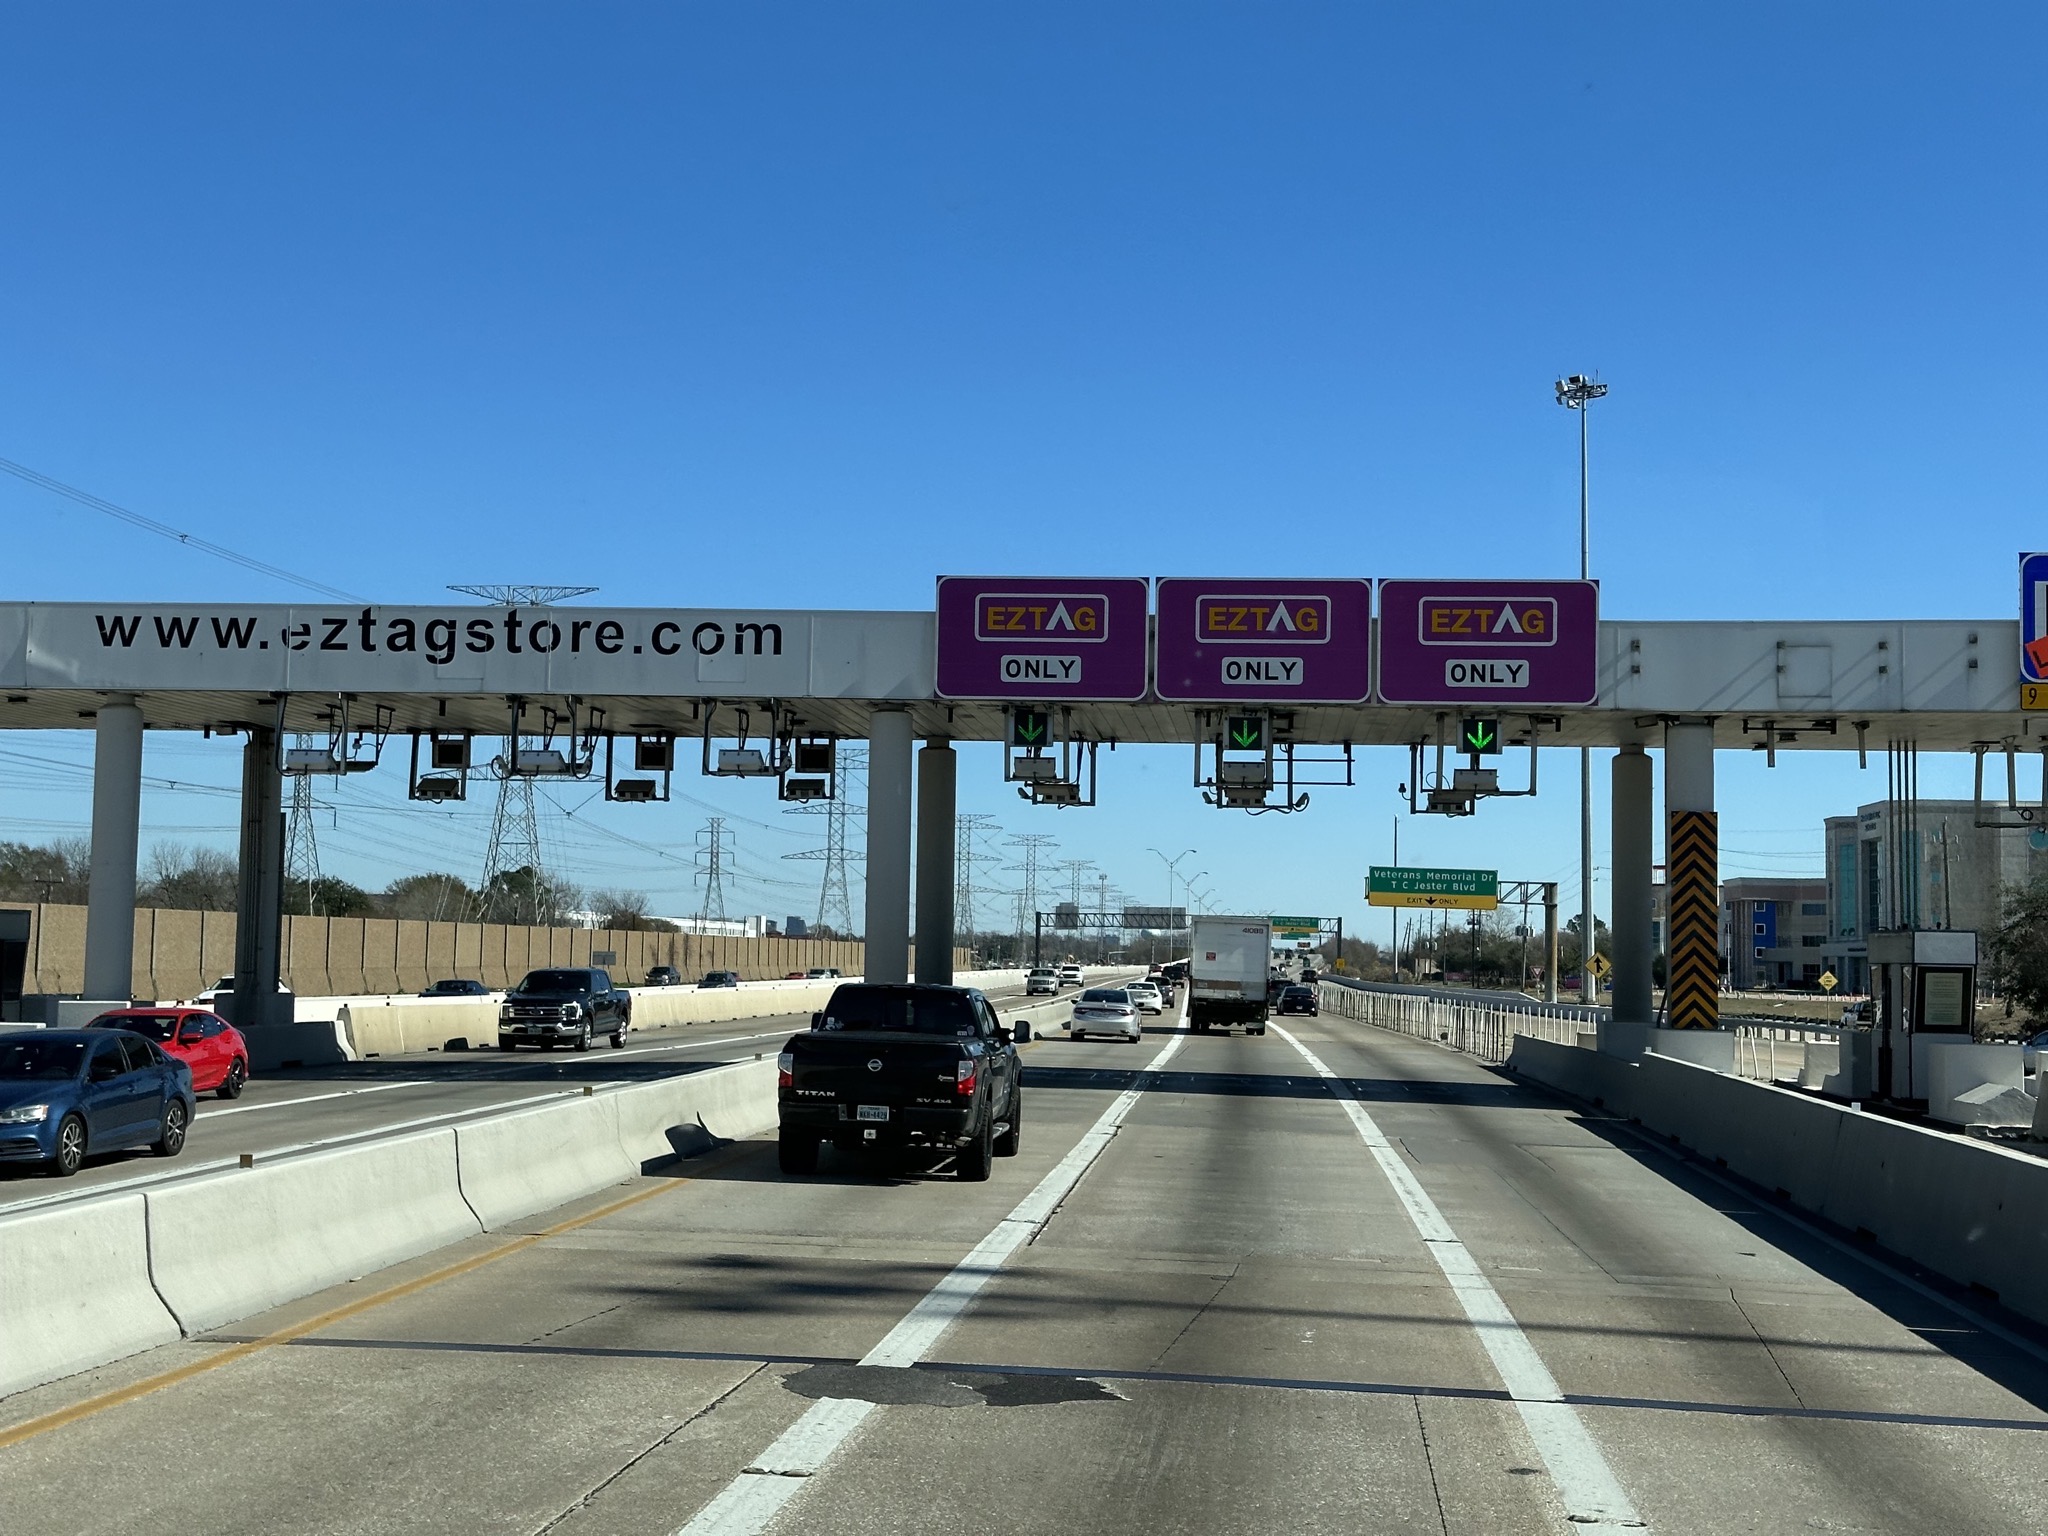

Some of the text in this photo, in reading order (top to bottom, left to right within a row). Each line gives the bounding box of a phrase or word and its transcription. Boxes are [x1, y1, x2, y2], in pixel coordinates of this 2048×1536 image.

[988, 600, 1096, 631] EZTAG
[1209, 601, 1318, 632] EZTAG
[1431, 602, 1544, 634] EZTAG
[95, 607, 783, 664] www.eztagstore.com
[1005, 659, 1076, 679] ONLY
[1226, 661, 1297, 681] ONLY
[1450, 663, 1523, 683] ONLY
[1374, 870, 1494, 882] Veterans Memorial Dr
[1391, 881, 1476, 892] T C Jester Blvd
[1438, 898, 1459, 906] ONLY
